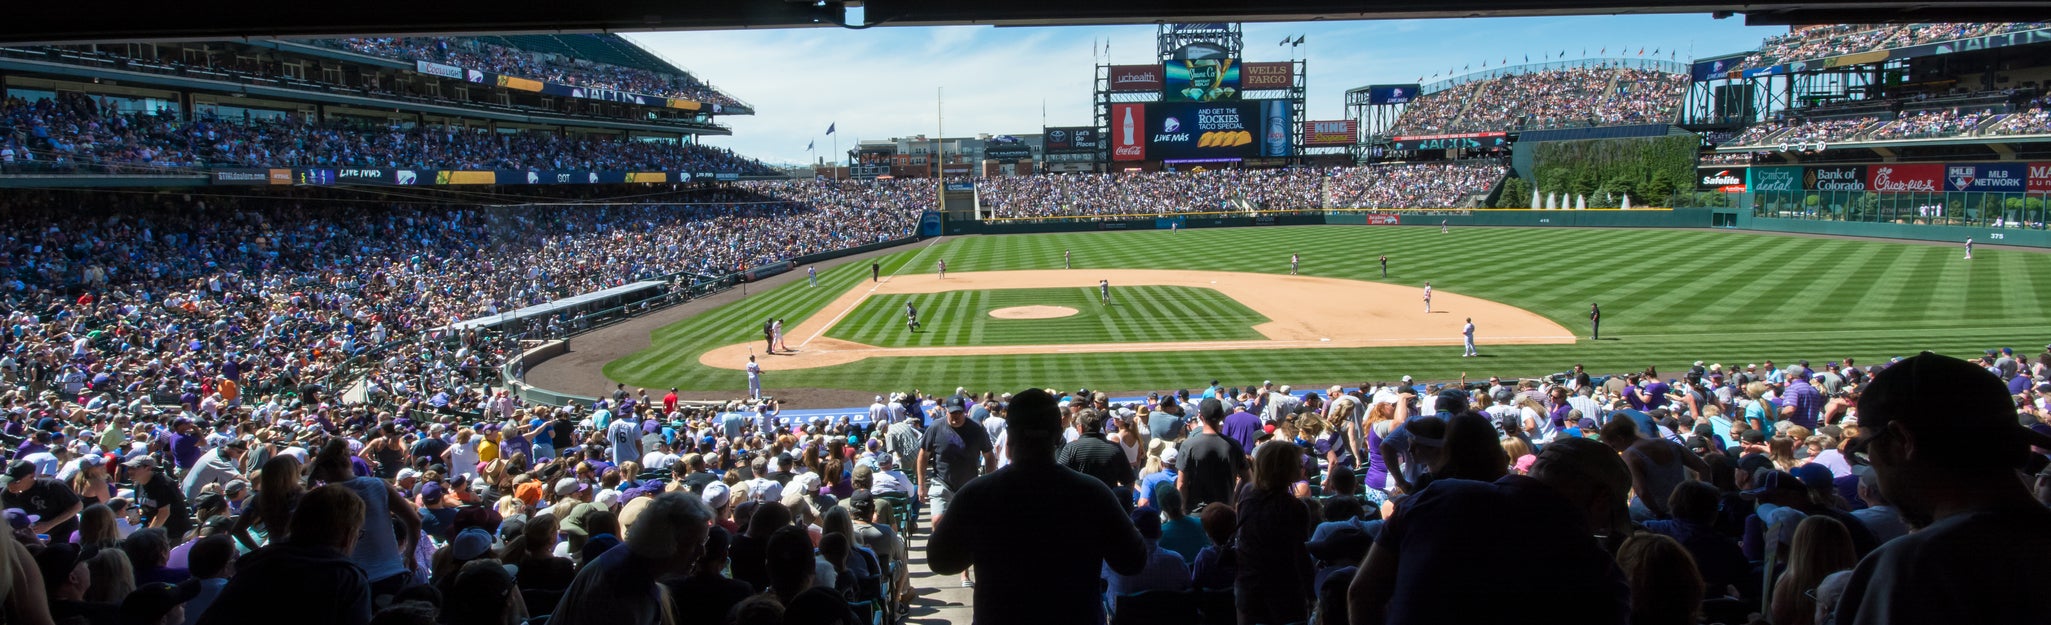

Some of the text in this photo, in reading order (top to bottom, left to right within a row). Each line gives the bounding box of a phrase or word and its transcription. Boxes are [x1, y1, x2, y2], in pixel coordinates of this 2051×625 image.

[1247, 66, 1287, 75] WELLS
[1118, 72, 1156, 83] uchealth
[1247, 75, 1287, 84] FARGO
[1198, 114, 1239, 124] ROCKIES
[1217, 122, 1244, 130] SPECIAL
[1315, 122, 1348, 134] KING
[1154, 133, 1172, 143] LIVE
[557, 173, 571, 184] GOT
[1758, 168, 1790, 180] Comfort
[1817, 167, 1857, 180] Bank of
[1988, 170, 2009, 178] MLB
[1702, 175, 1740, 185] Safelite
[1755, 176, 1794, 191] dental
[1816, 179, 1865, 191] Colorado
[1874, 172, 1935, 191] Chick-fil-A
[1974, 178, 2020, 187] NETWORK
[71, 376, 82, 384] 23
[616, 431, 627, 444] 16
